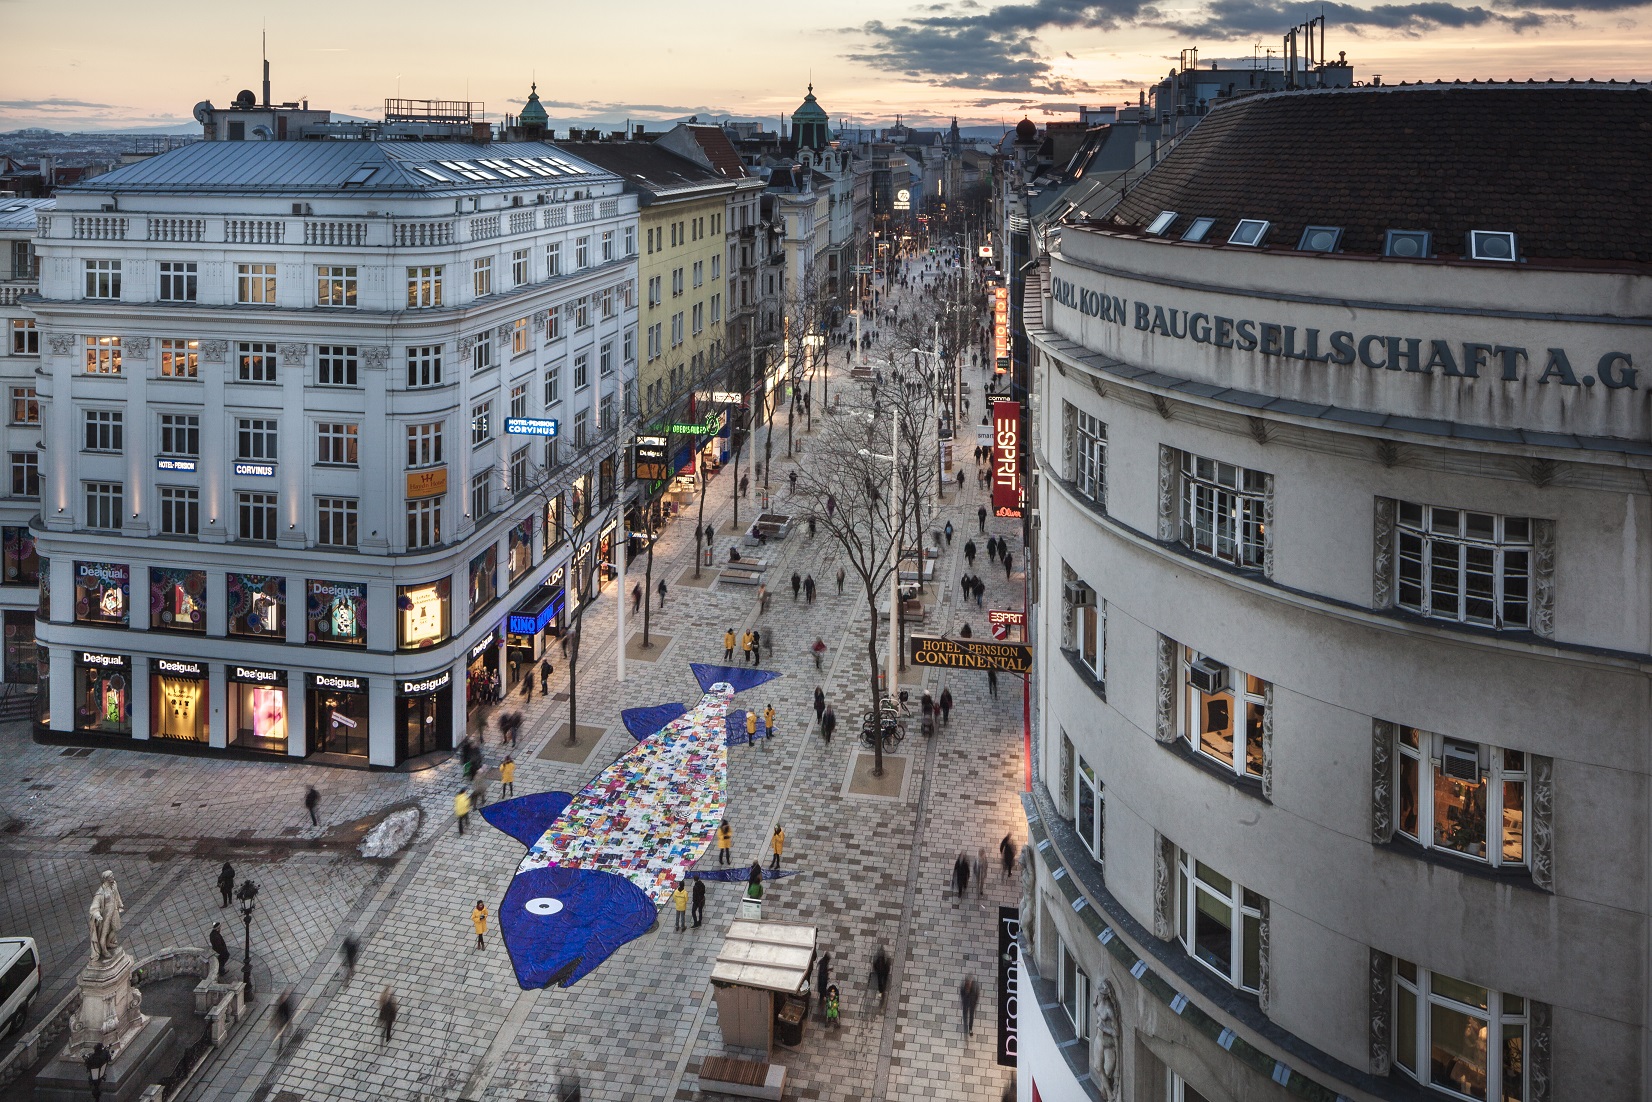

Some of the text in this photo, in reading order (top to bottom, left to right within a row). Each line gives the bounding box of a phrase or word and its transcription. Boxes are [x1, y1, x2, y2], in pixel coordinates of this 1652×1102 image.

[996, 290, 1006, 371] KOMOLK
[1052, 276, 1078, 309] CARL
[1079, 286, 1127, 326] KORN
[1133, 300, 1528, 381] BAUGESELLSCHAFT
[508, 426, 555, 435] CORVINUS
[997, 418, 1016, 491] ESPRIT
[236, 465, 273, 476] CORVINUS
[510, 618, 536, 632] KINO
[990, 612, 1023, 624] ESPRIT
[923, 640, 1019, 657] HOTEL PENSION
[915, 651, 1027, 671] CONTINENTAL
